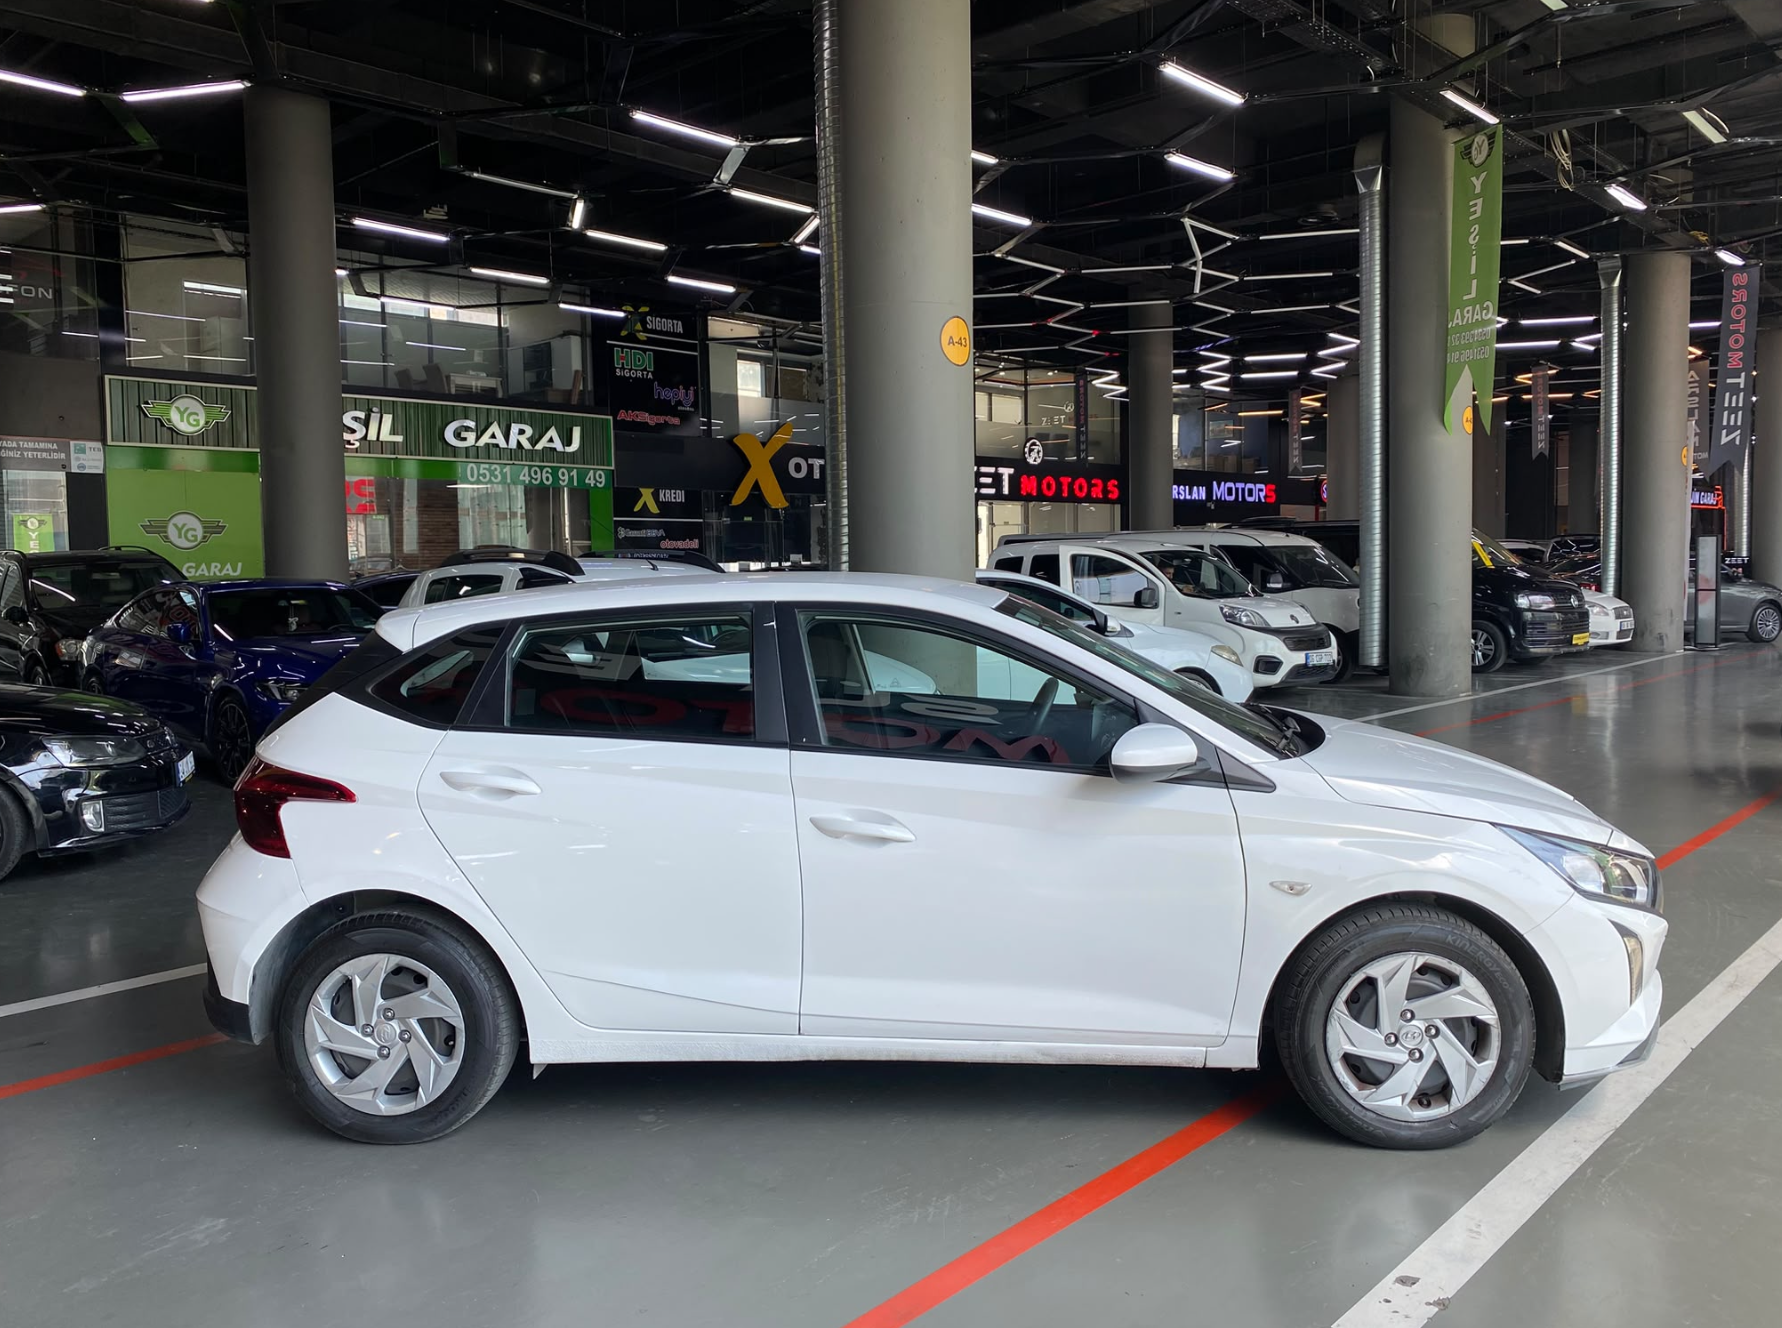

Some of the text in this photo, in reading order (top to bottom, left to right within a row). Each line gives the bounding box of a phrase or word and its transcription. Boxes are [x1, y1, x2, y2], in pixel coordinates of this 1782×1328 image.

[947, 335, 968, 348] A-43
[614, 347, 654, 371] HDI
[173, 404, 200, 428] YG
[444, 419, 581, 452] GARAJ
[466, 463, 605, 488] 0531 496 91 49
[788, 456, 825, 480] OT
[974, 466, 1120, 500] ET MOTORS
[1212, 481, 1277, 504] MOTORS
[172, 523, 198, 543] YG
[182, 562, 242, 576] GARAJ
